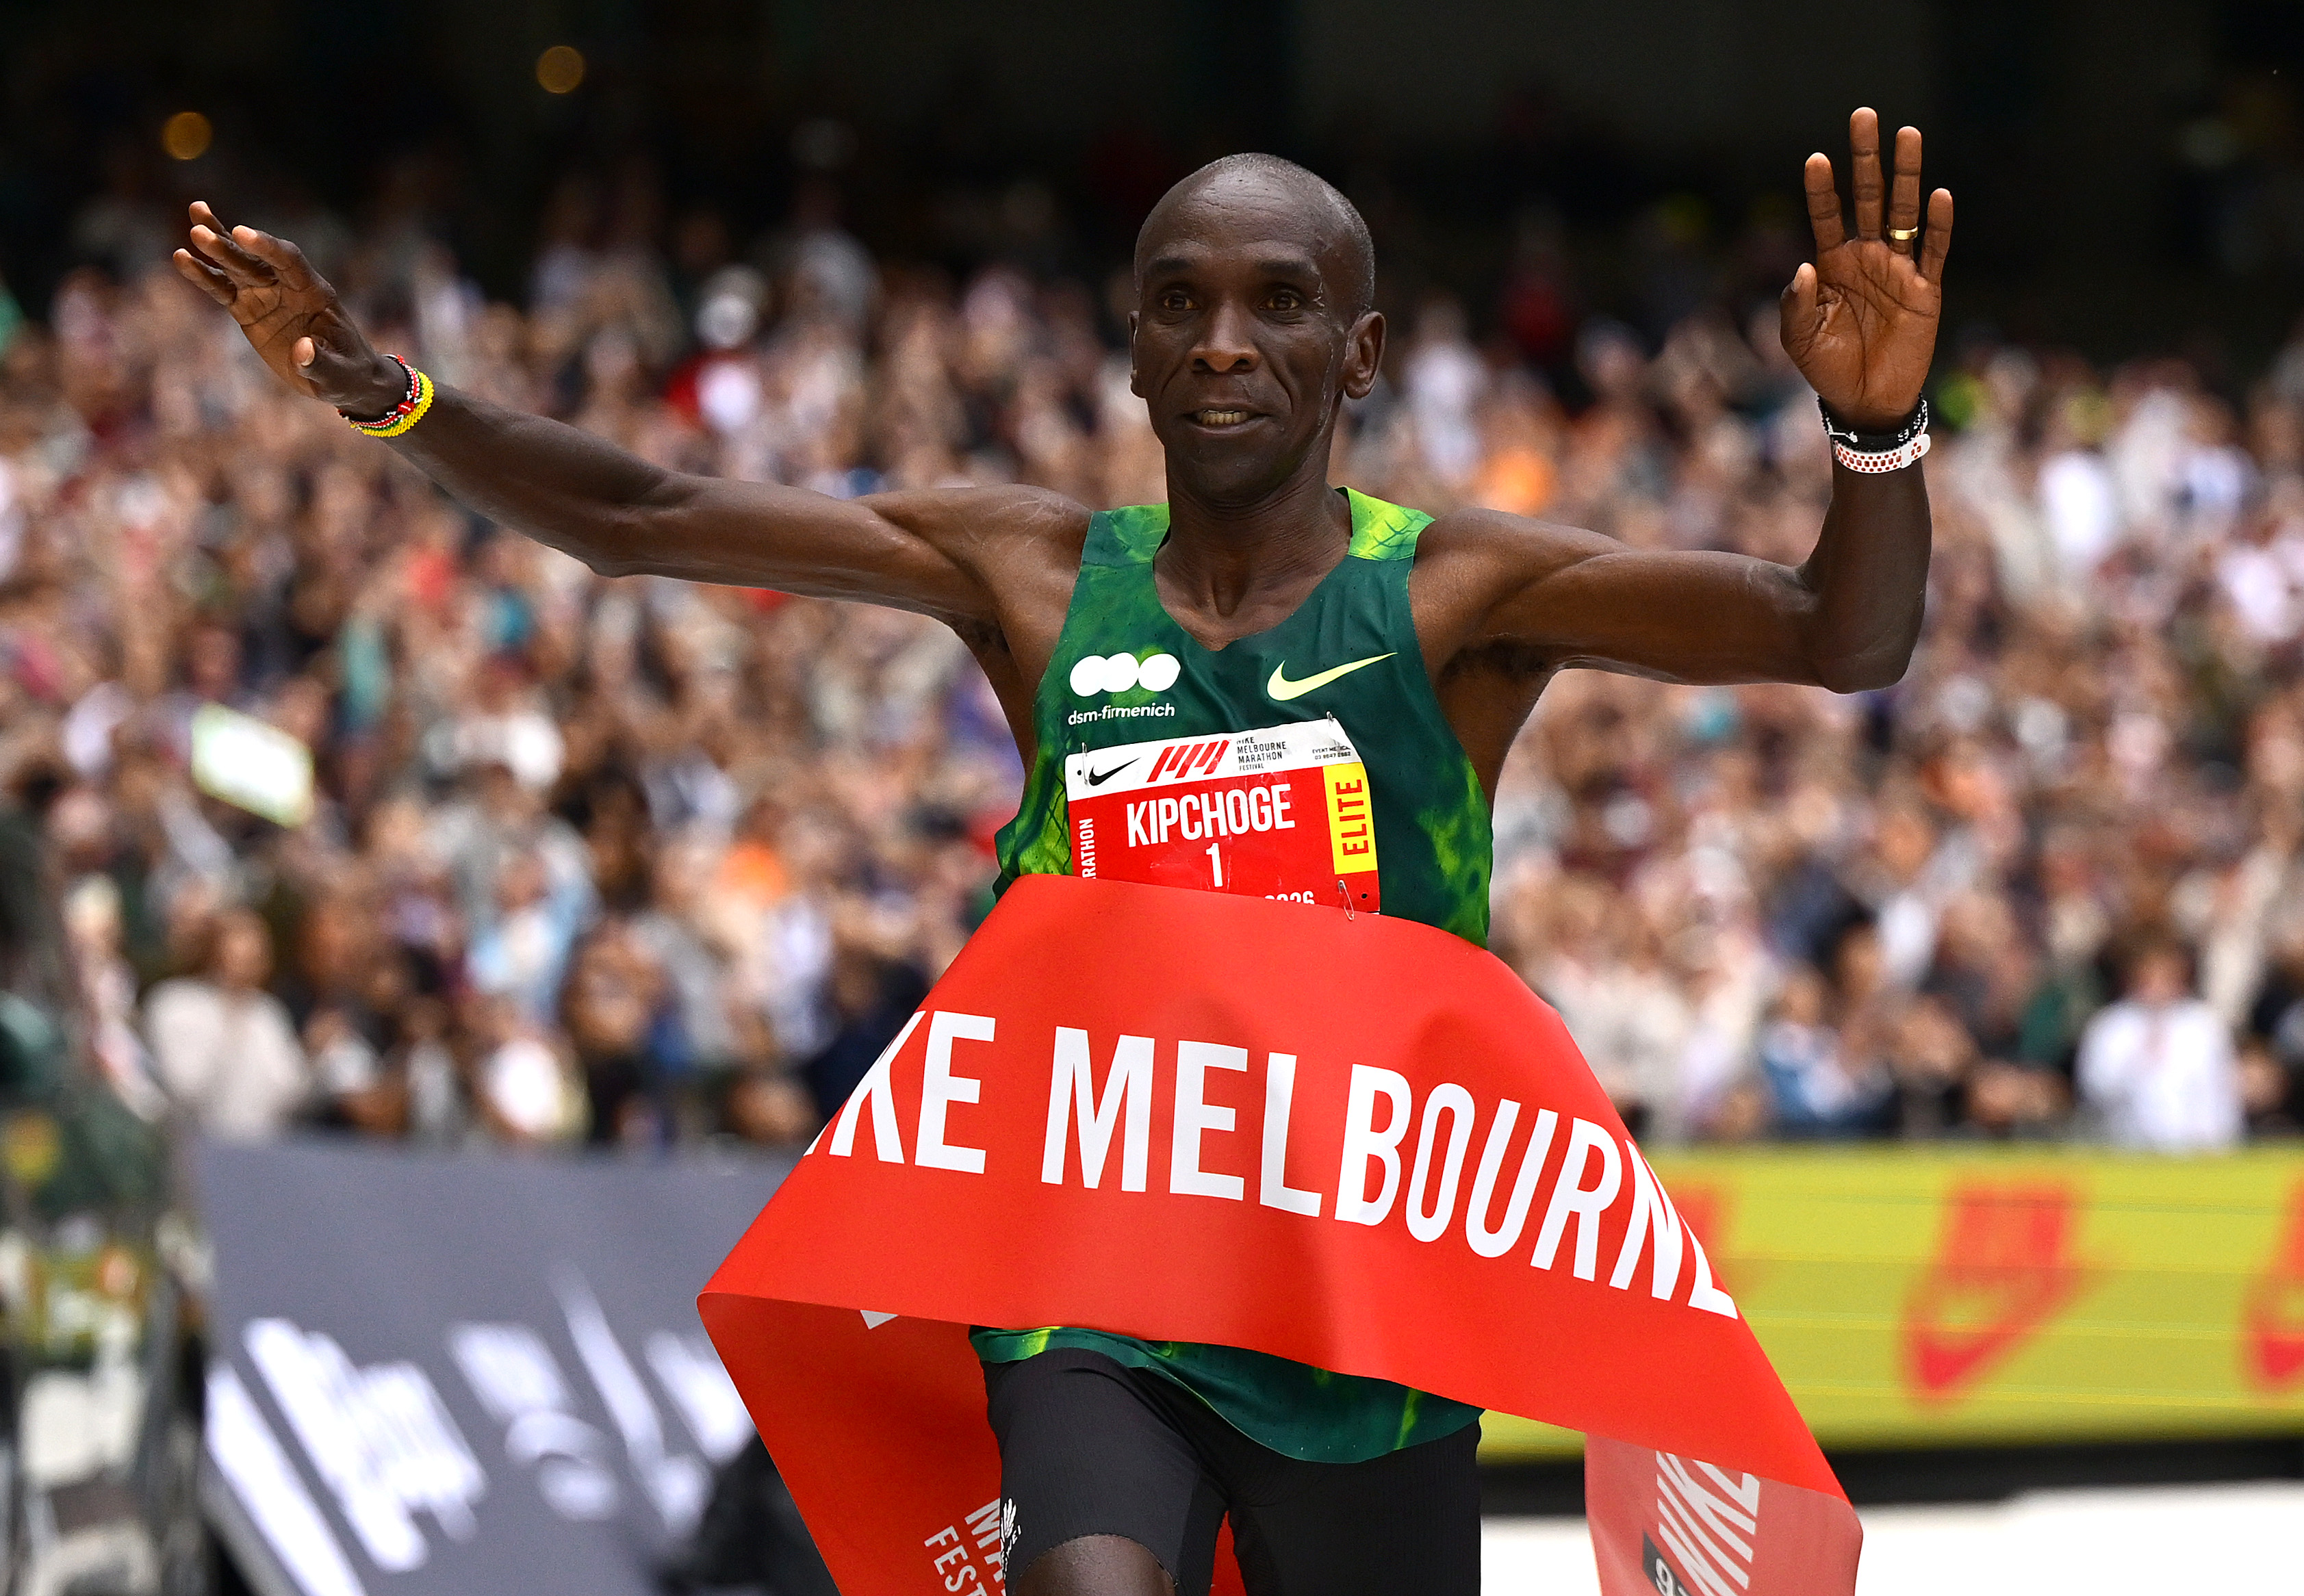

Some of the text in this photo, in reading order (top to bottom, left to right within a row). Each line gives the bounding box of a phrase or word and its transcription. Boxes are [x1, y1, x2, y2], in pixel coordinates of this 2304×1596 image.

[1068, 702, 1175, 725] dsm-firmenich
[1237, 741, 1287, 754] MELBOURNE
[1238, 751, 1282, 764] MARATHON
[1239, 763, 1264, 771] FESTIVAL
[1127, 784, 1295, 847] KIPCHOGE
[1335, 779, 1369, 855] ELITE
[1079, 818, 1097, 879] RATHON
[1205, 842, 1223, 887] 1
[803, 1010, 996, 1174] KE
